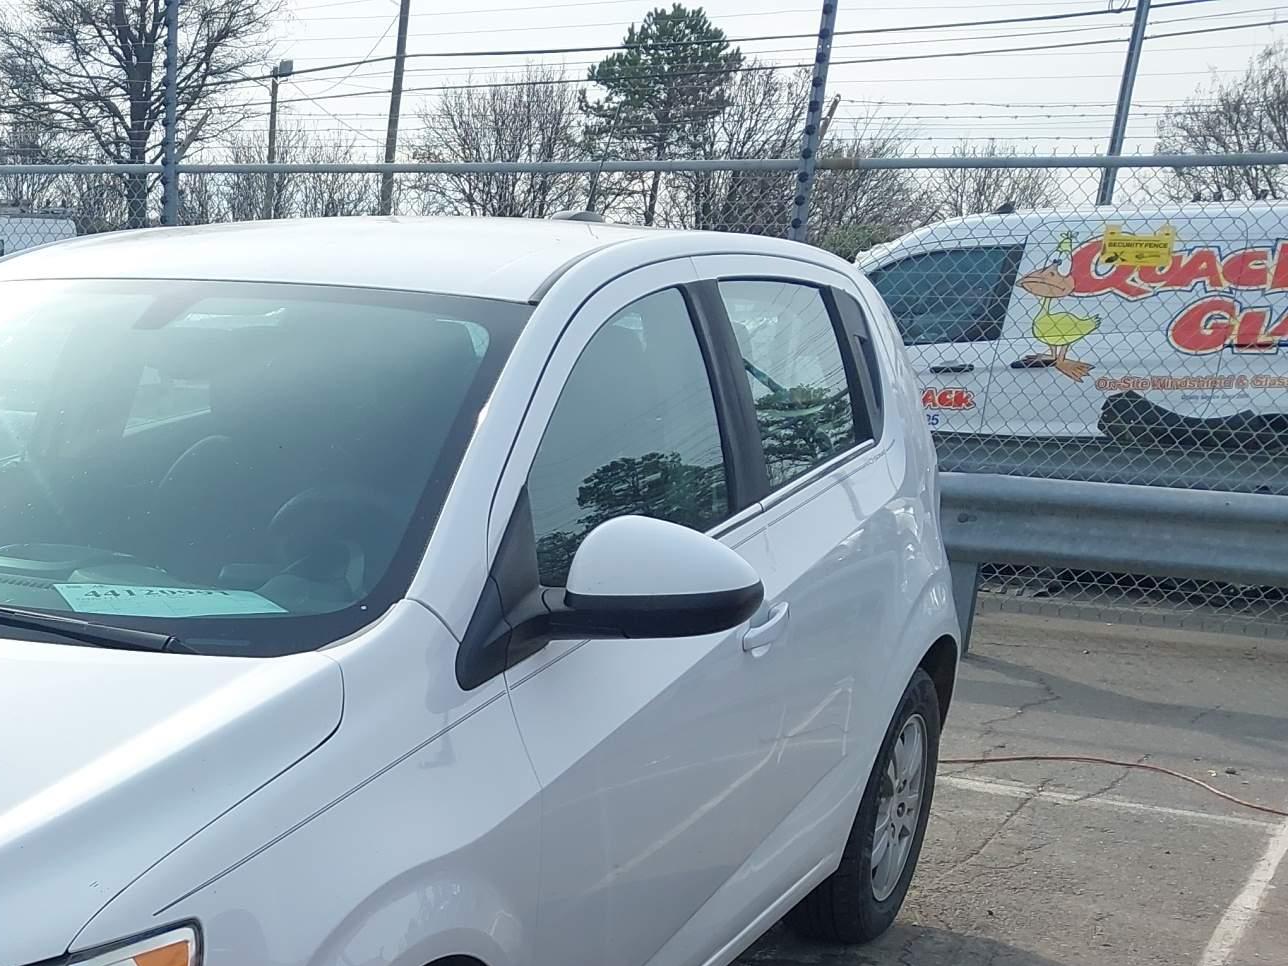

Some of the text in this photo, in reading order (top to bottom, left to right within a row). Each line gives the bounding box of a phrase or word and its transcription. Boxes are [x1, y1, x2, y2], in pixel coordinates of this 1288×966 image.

[1096, 376, 1150, 390] On-Site
[1151, 375, 1234, 390] Windshield
[1250, 375, 1288, 389] Glas
[920, 387, 976, 411] ACK
